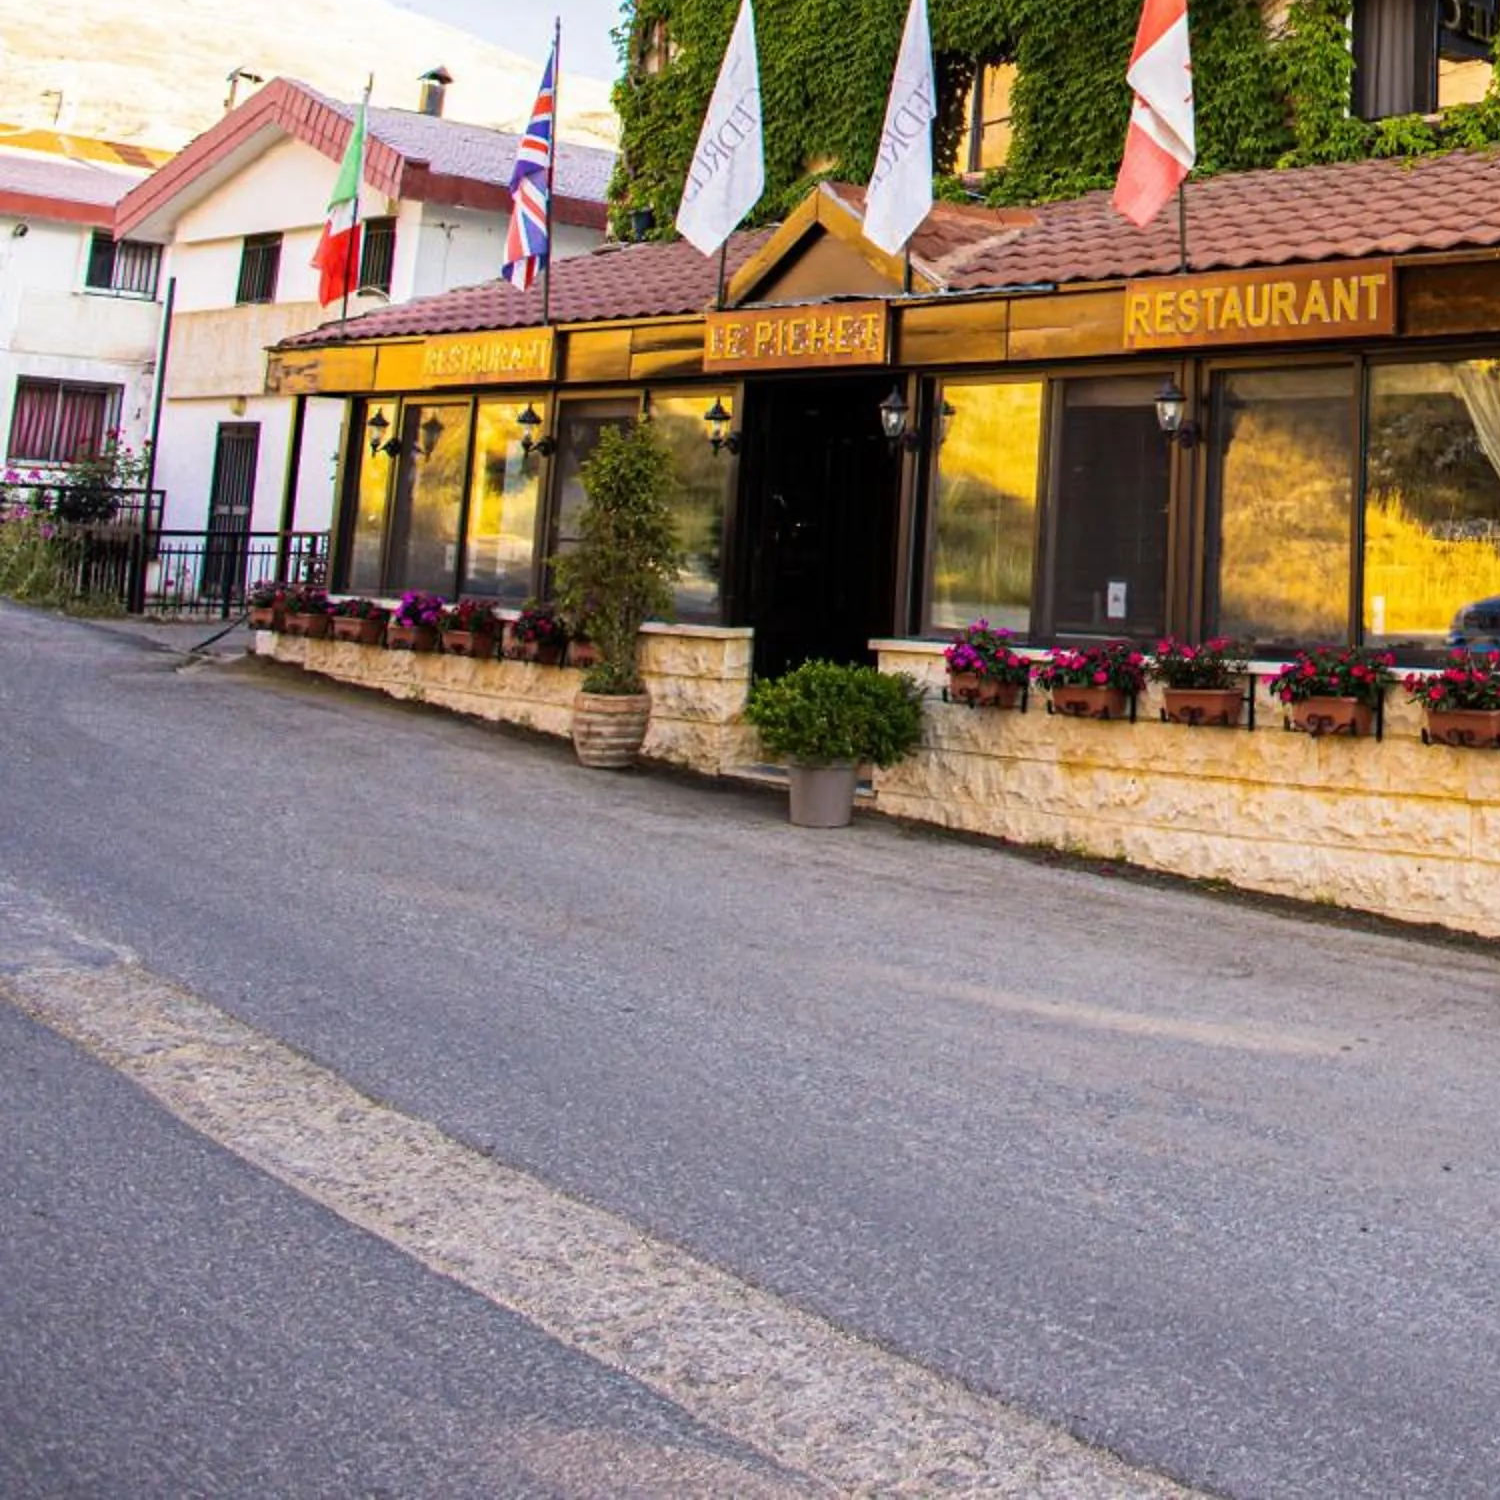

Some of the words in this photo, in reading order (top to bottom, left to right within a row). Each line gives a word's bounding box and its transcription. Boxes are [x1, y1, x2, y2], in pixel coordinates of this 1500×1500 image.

[1128, 273, 1387, 336] RESTAURANT
[424, 339, 549, 376] RESTAURANT
[707, 323, 742, 361] LE
[754, 312, 880, 358] PICHET
